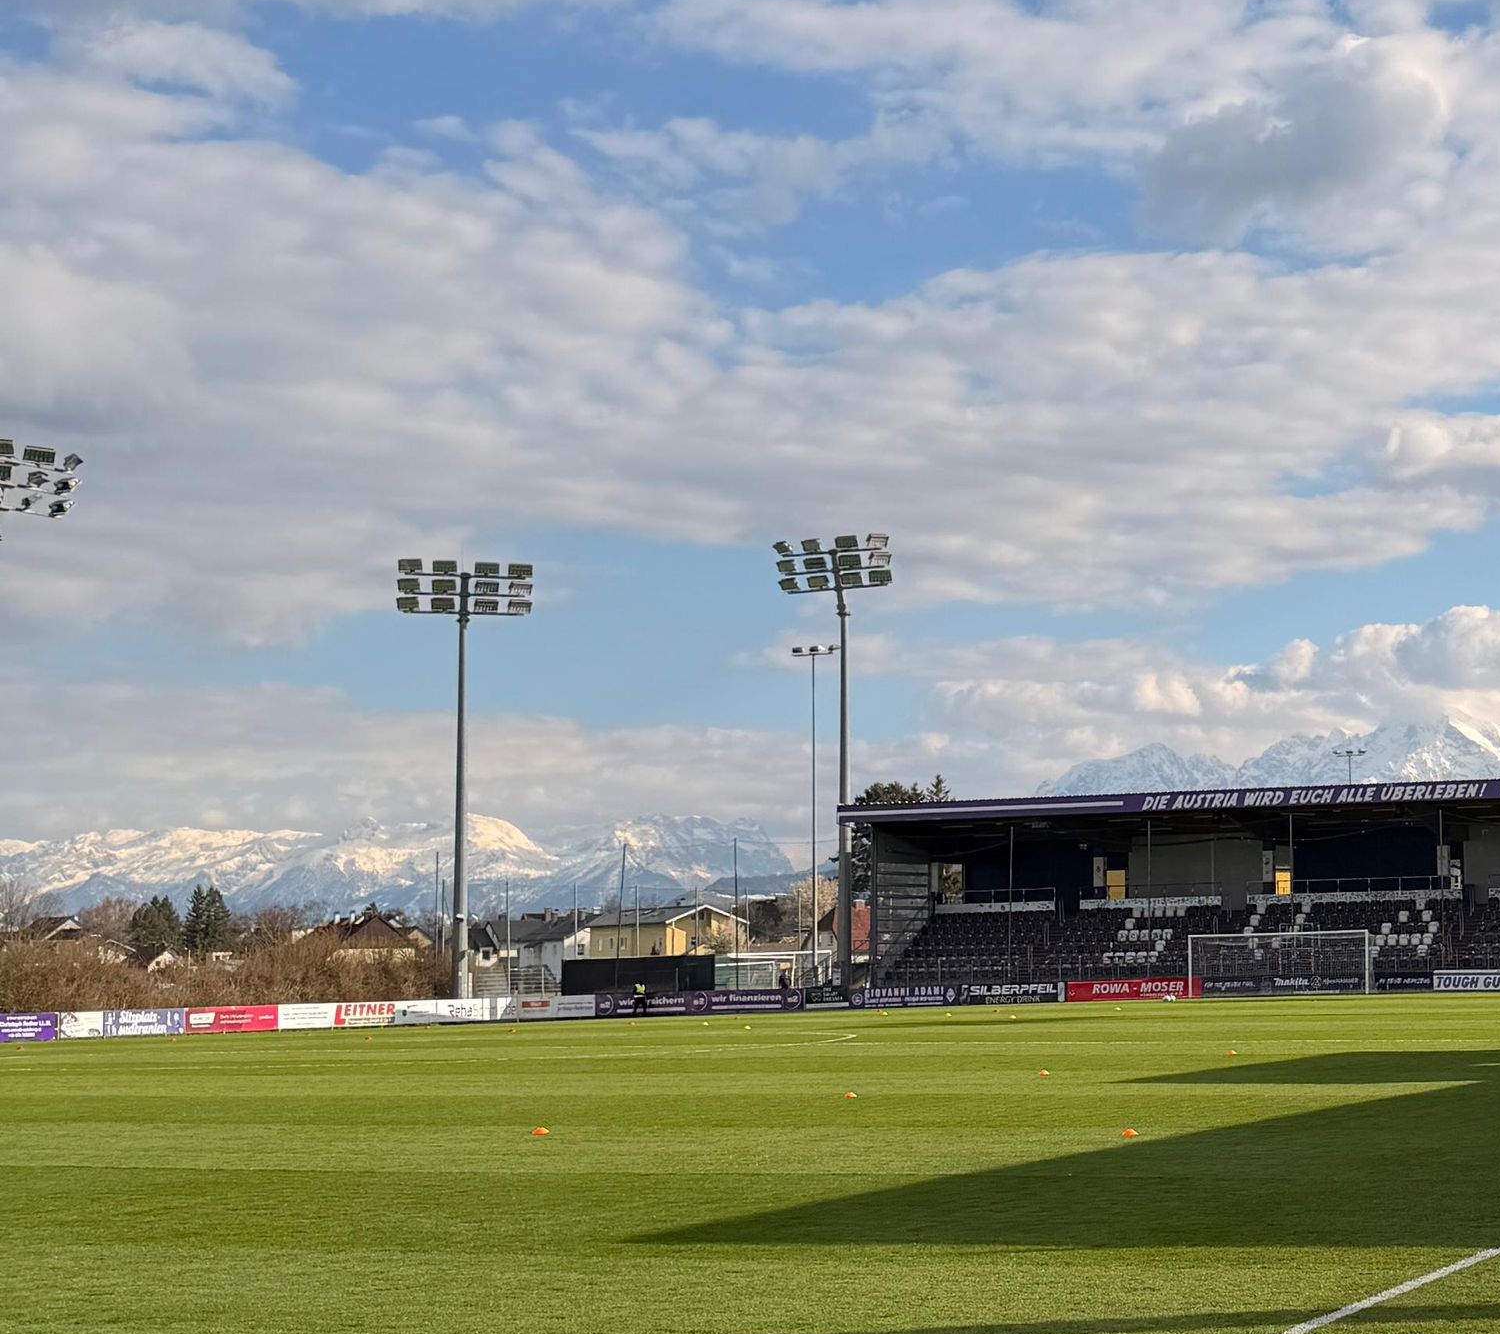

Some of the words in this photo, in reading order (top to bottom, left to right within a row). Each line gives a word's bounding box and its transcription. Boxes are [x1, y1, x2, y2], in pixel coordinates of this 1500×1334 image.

[1142, 795, 1170, 811] DIE
[1172, 792, 1238, 809] AUSTRIA
[1244, 790, 1284, 807] WIRD
[1289, 788, 1334, 804] EUCH
[1337, 786, 1377, 803] ALLE
[1381, 782, 1487, 801] ÜBERLEBEN!
[1092, 983, 1130, 994] ROWA
[1140, 981, 1184, 993] MOSER
[1436, 975, 1480, 988] TOUGH
[864, 987, 910, 998] GIOVANNI
[914, 985, 944, 996] ADAMI
[969, 984, 1057, 997] SILBERPFEIL
[647, 996, 685, 1005] rsichern
[711, 994, 727, 1003] wir
[729, 993, 782, 1003] finanzieren
[986, 995, 1015, 1004] ENERGY
[1017, 994, 1041, 1003] DRINK
[334, 1004, 396, 1025] LEITNER
